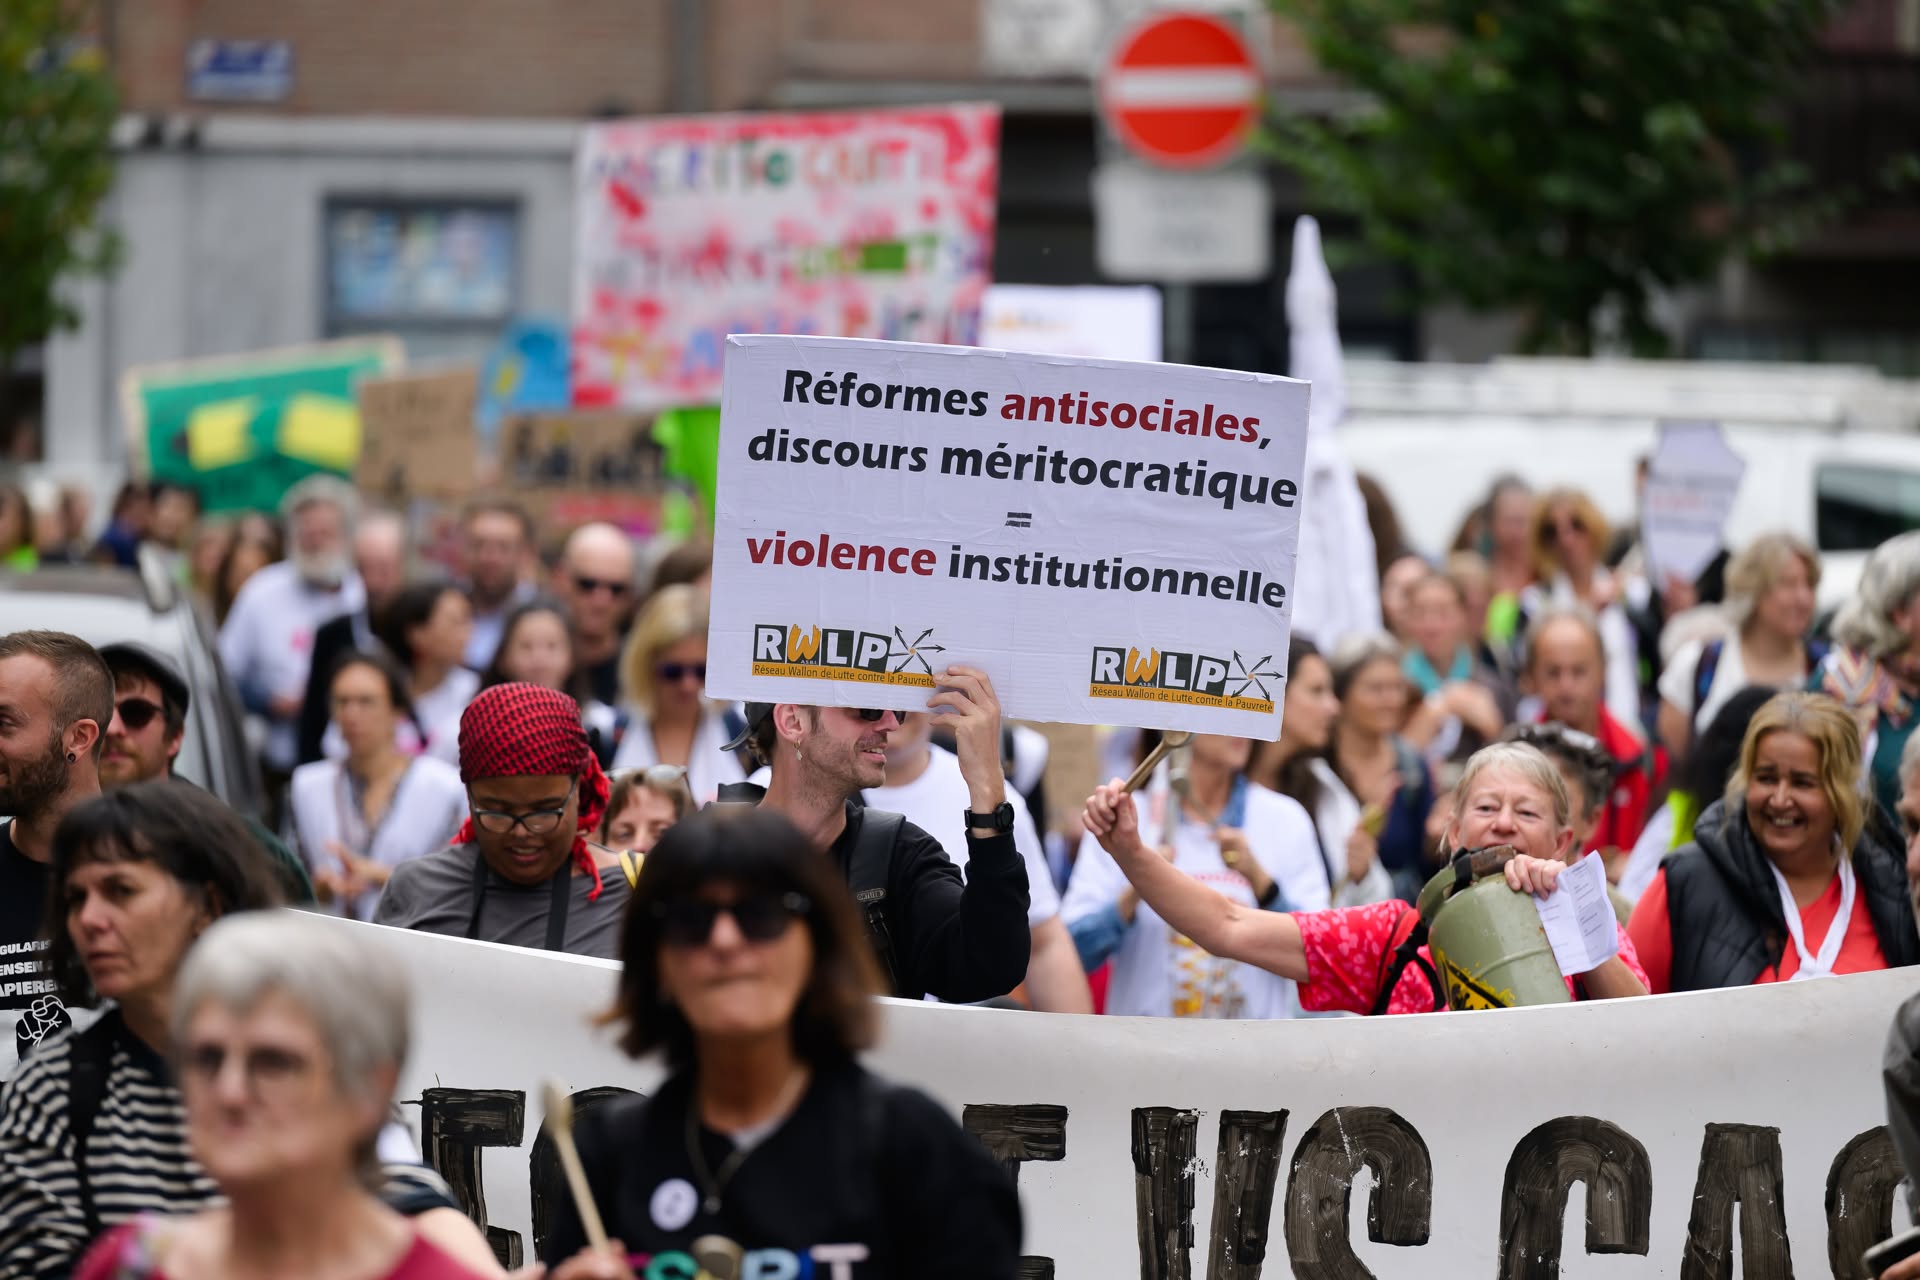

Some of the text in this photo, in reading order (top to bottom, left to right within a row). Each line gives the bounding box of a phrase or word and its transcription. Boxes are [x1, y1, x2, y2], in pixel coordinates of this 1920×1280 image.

[783, 370, 1272, 450] Réformes antisociales,
[747, 428, 1298, 511] discours méritocratique
[746, 530, 1286, 608] violence institutionnelle
[754, 624, 890, 669] RWLP
[1092, 646, 1229, 694] RWLP
[754, 664, 786, 676] Réseau
[788, 666, 818, 677] Wallon
[821, 668, 832, 679] de
[833, 669, 855, 680] Lutte
[857, 672, 885, 682] contre
[887, 672, 895, 683] la
[1092, 686, 1273, 712] Réseau Wallon de Lutte contre la Pauvreté
